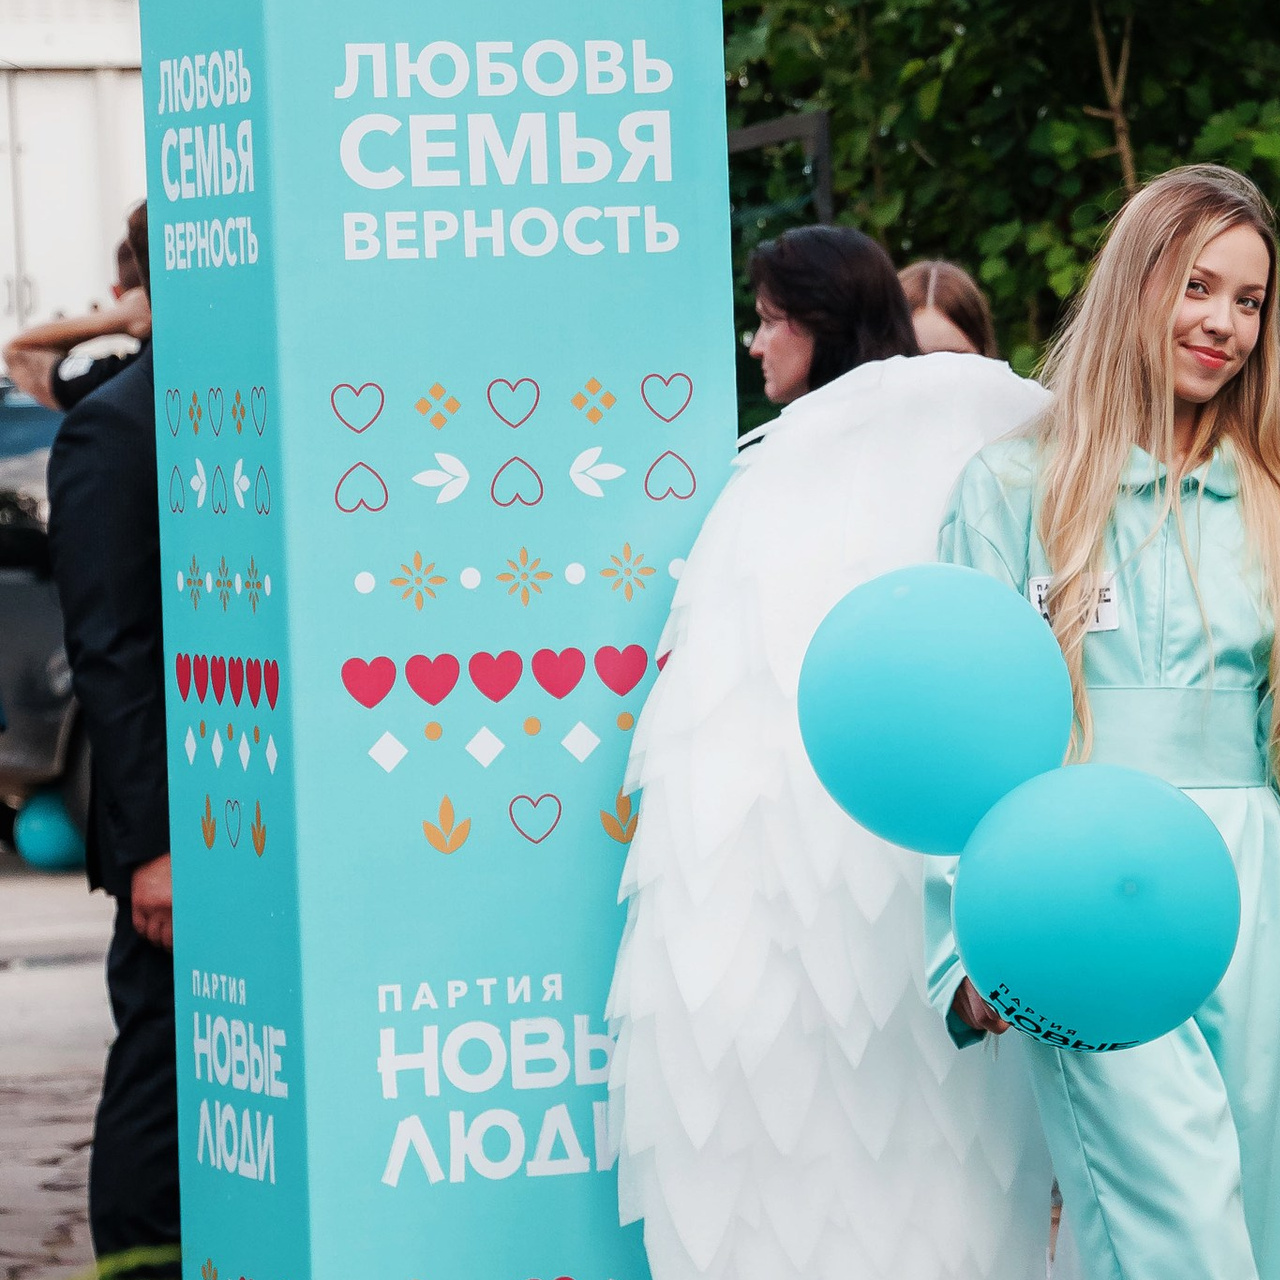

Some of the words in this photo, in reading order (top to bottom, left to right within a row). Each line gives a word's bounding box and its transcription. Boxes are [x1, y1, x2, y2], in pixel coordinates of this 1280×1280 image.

[158, 48, 252, 115] ЛЮБОВЬ
[334, 39, 674, 100] ЛЮБОВЬ
[161, 119, 255, 202] СЕМЬЯ
[339, 110, 673, 190] СЕМЬЯ
[164, 217, 259, 271] ВЕРНОСТЬ
[342, 205, 680, 261] ВЕРНОСТЬ
[192, 969, 246, 1006] ПАРТИЯ
[378, 973, 563, 1013] ПАРТИЯ
[999, 982, 1078, 1037] ПАРТИЯ
[193, 1011, 288, 1100] НОВЫЕ
[197, 1098, 276, 1186] ЛЮДИ
